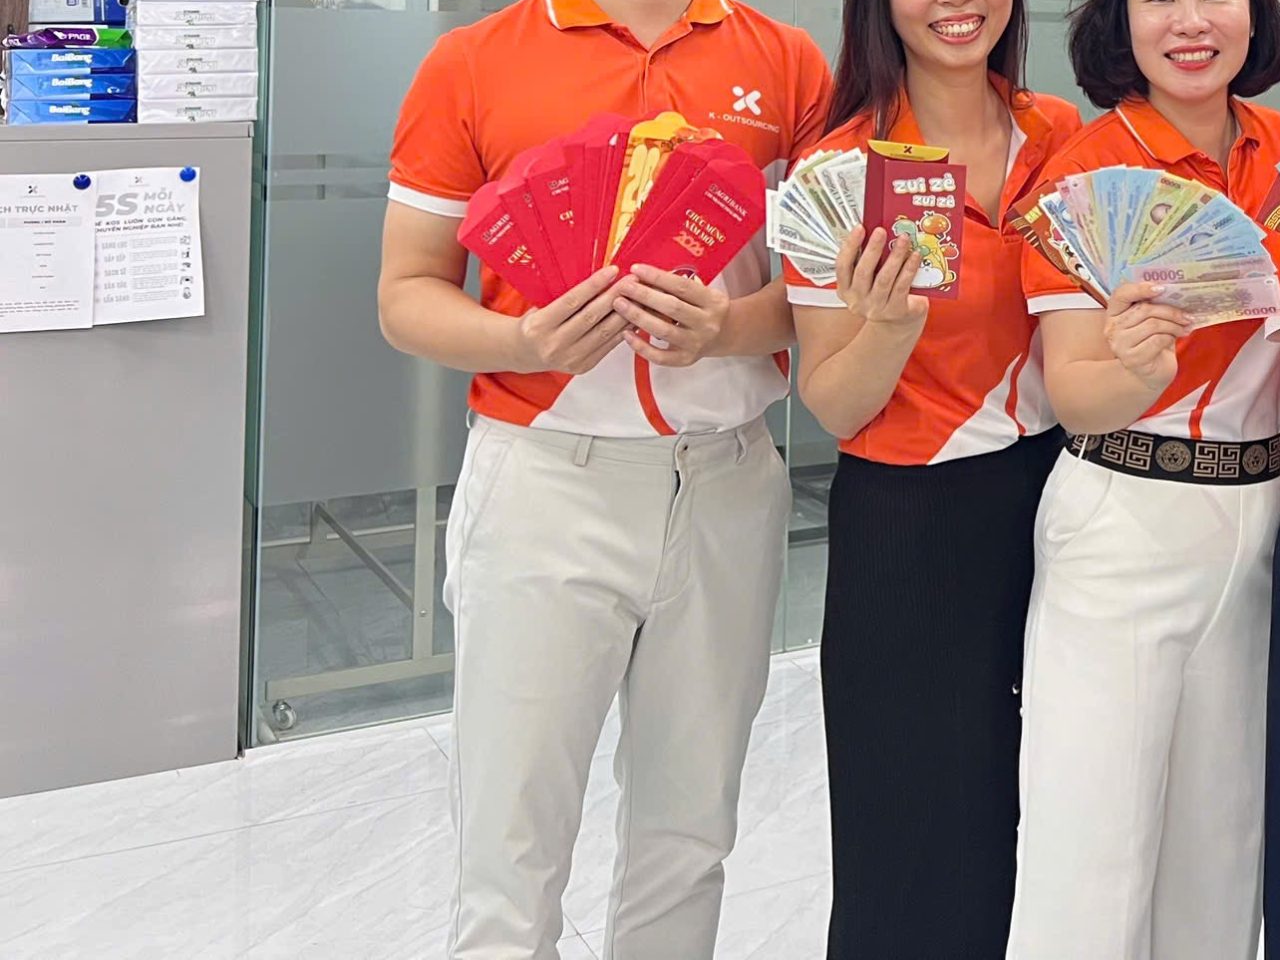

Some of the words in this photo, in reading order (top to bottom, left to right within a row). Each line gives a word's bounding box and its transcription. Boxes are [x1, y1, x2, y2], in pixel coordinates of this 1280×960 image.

[143, 187, 173, 201] MỖI
[15, 204, 45, 215] TRỰC
[48, 203, 78, 214] NHẬT
[95, 192, 139, 217] 5S
[143, 201, 185, 214] NGÀY
[714, 189, 748, 217] AGRIBANK
